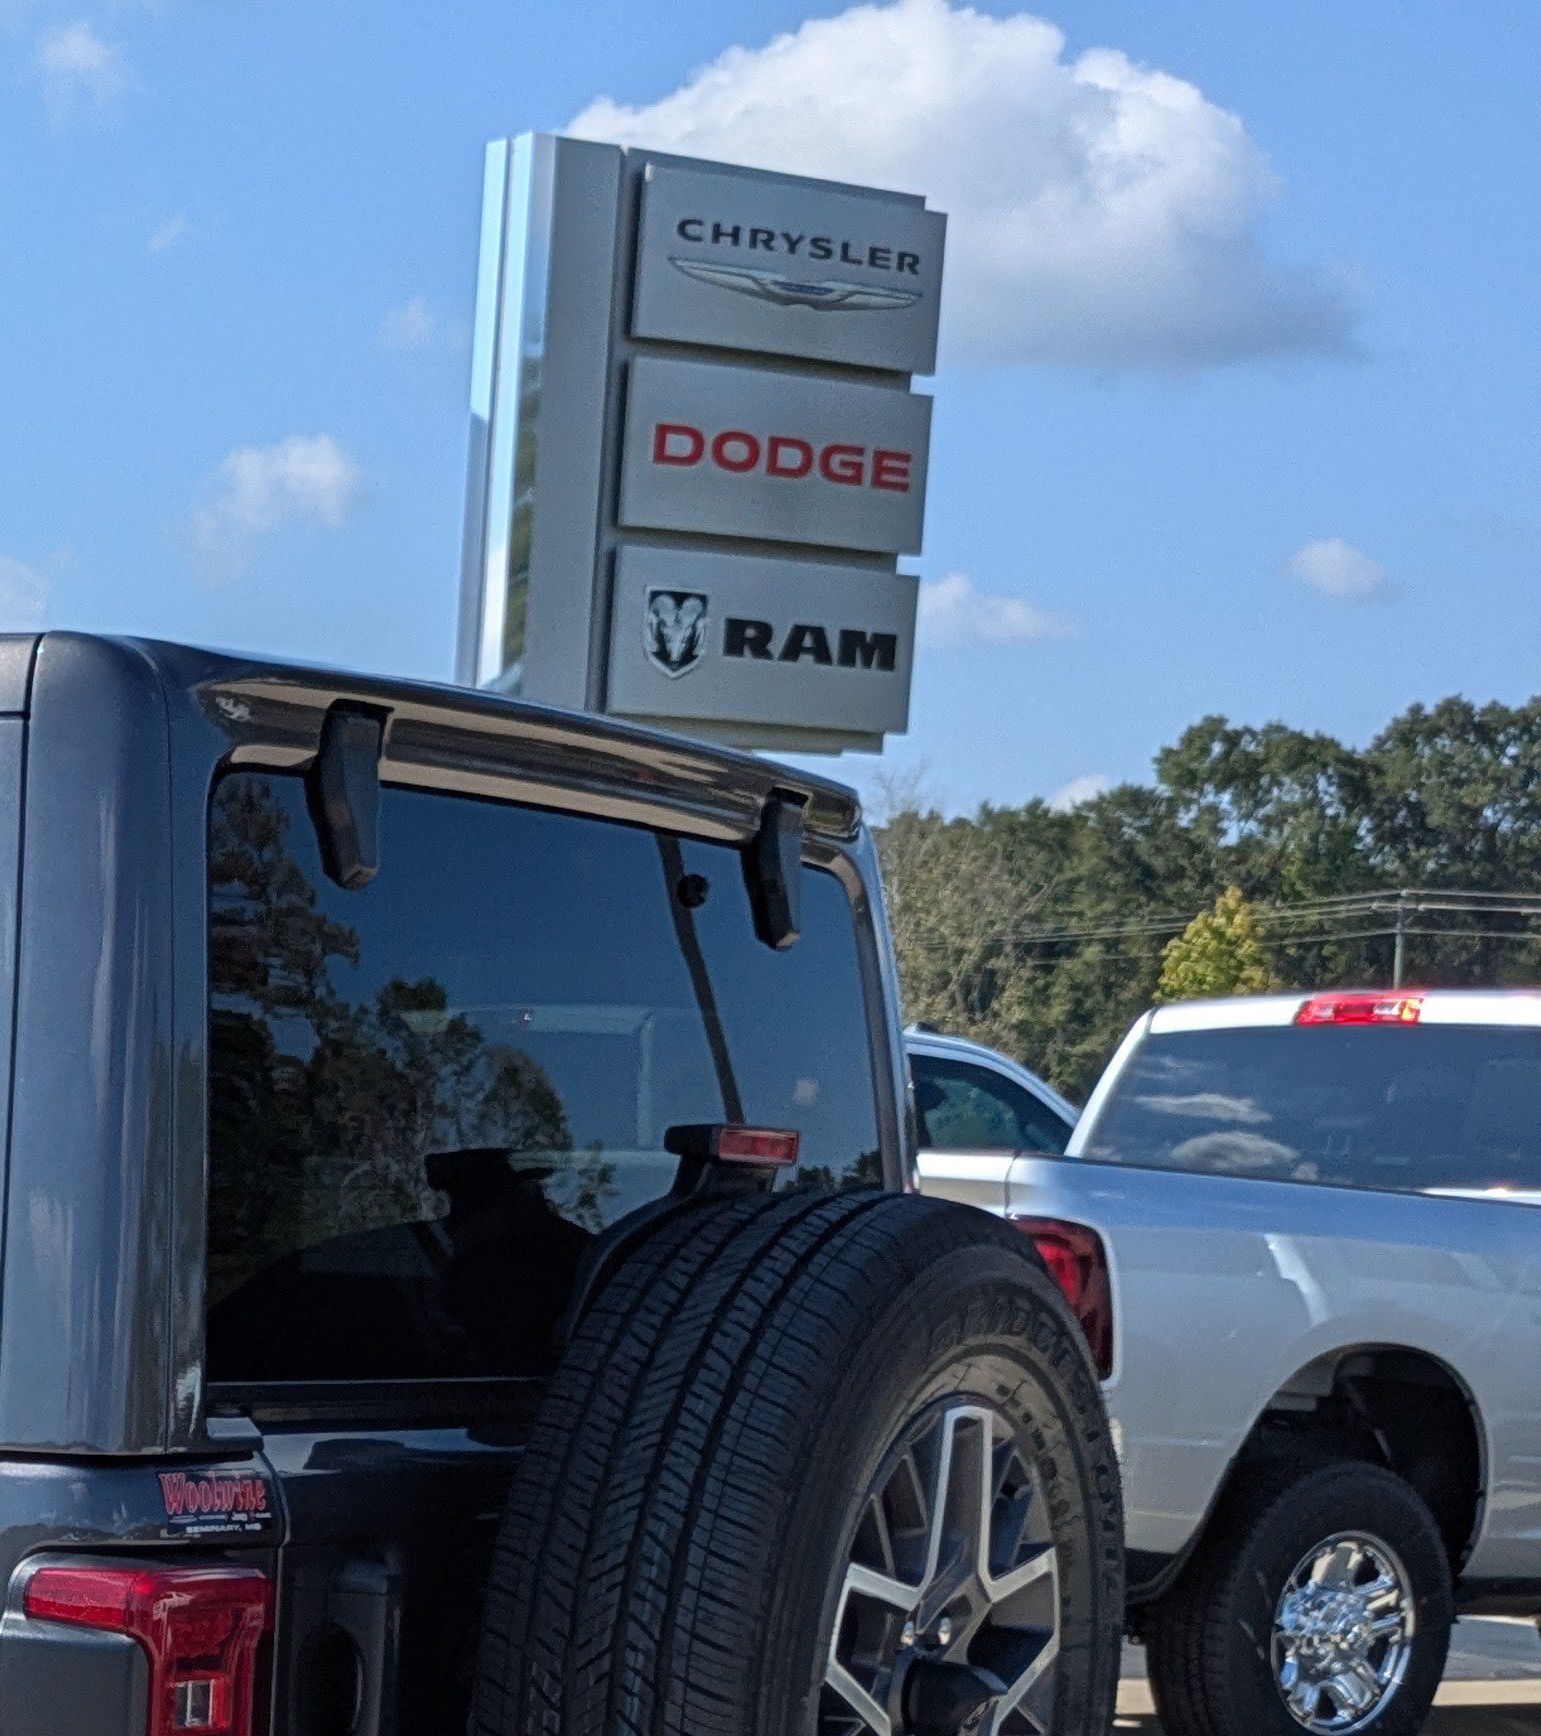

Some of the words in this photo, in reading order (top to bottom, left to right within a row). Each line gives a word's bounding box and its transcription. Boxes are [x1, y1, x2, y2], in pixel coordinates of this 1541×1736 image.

[676, 217, 920, 276] CHRYSLER
[652, 423, 912, 493] DODGE
[722, 617, 897, 673] RAM
